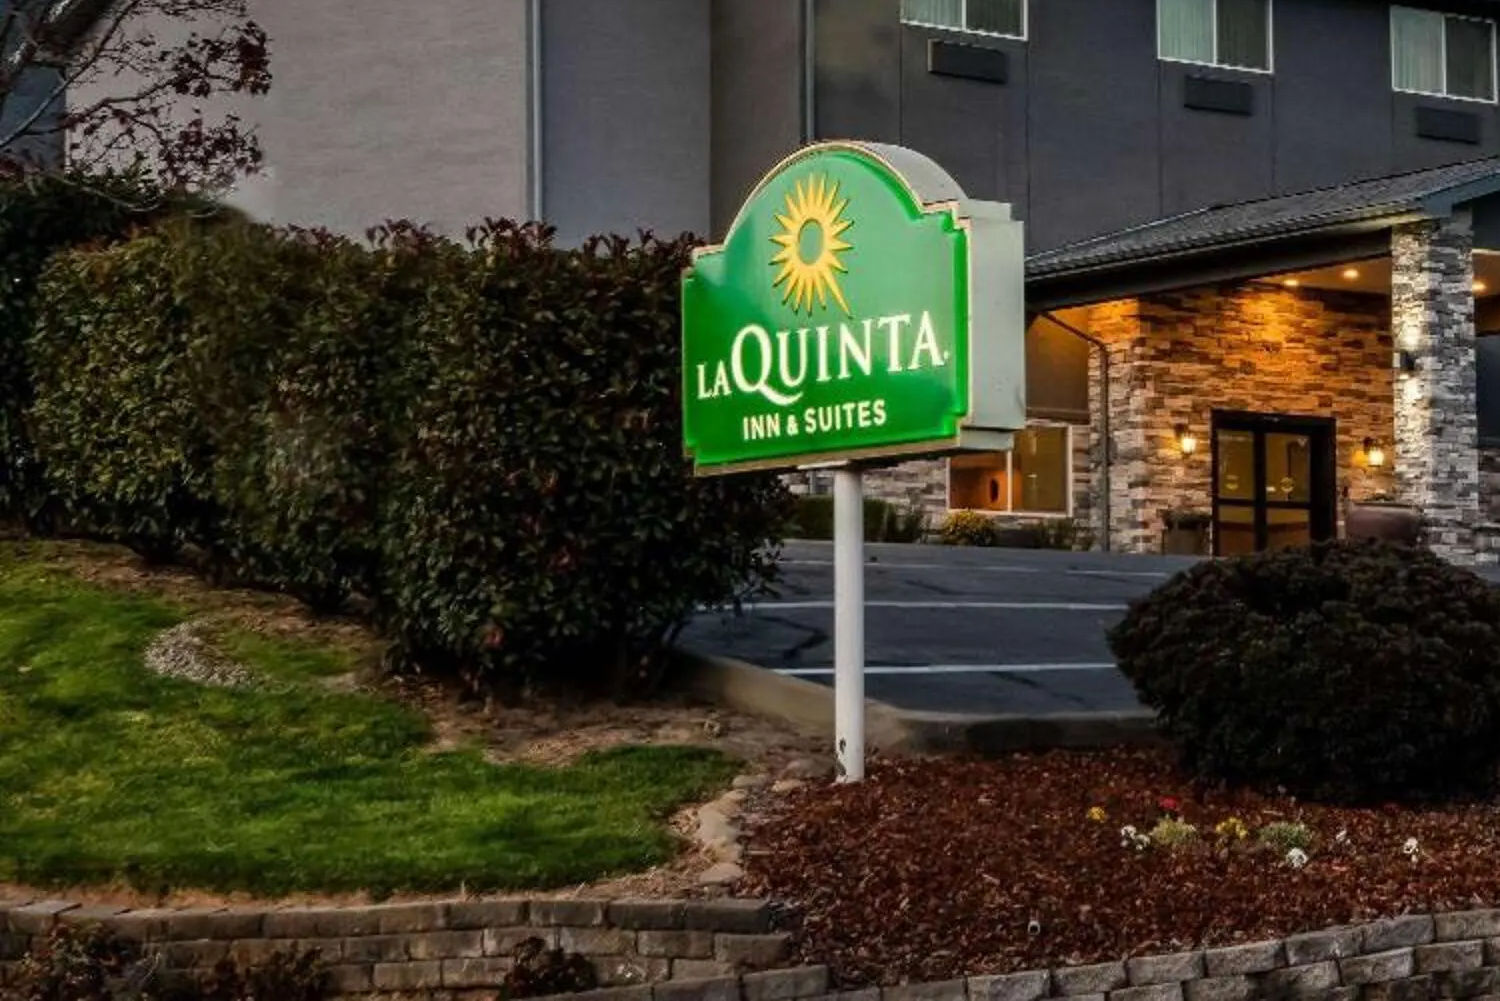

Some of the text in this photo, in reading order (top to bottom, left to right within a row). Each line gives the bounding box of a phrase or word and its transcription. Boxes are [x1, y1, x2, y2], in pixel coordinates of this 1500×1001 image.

[697, 310, 946, 406] LA QUINTA
[743, 399, 886, 441] INN & SUITES
